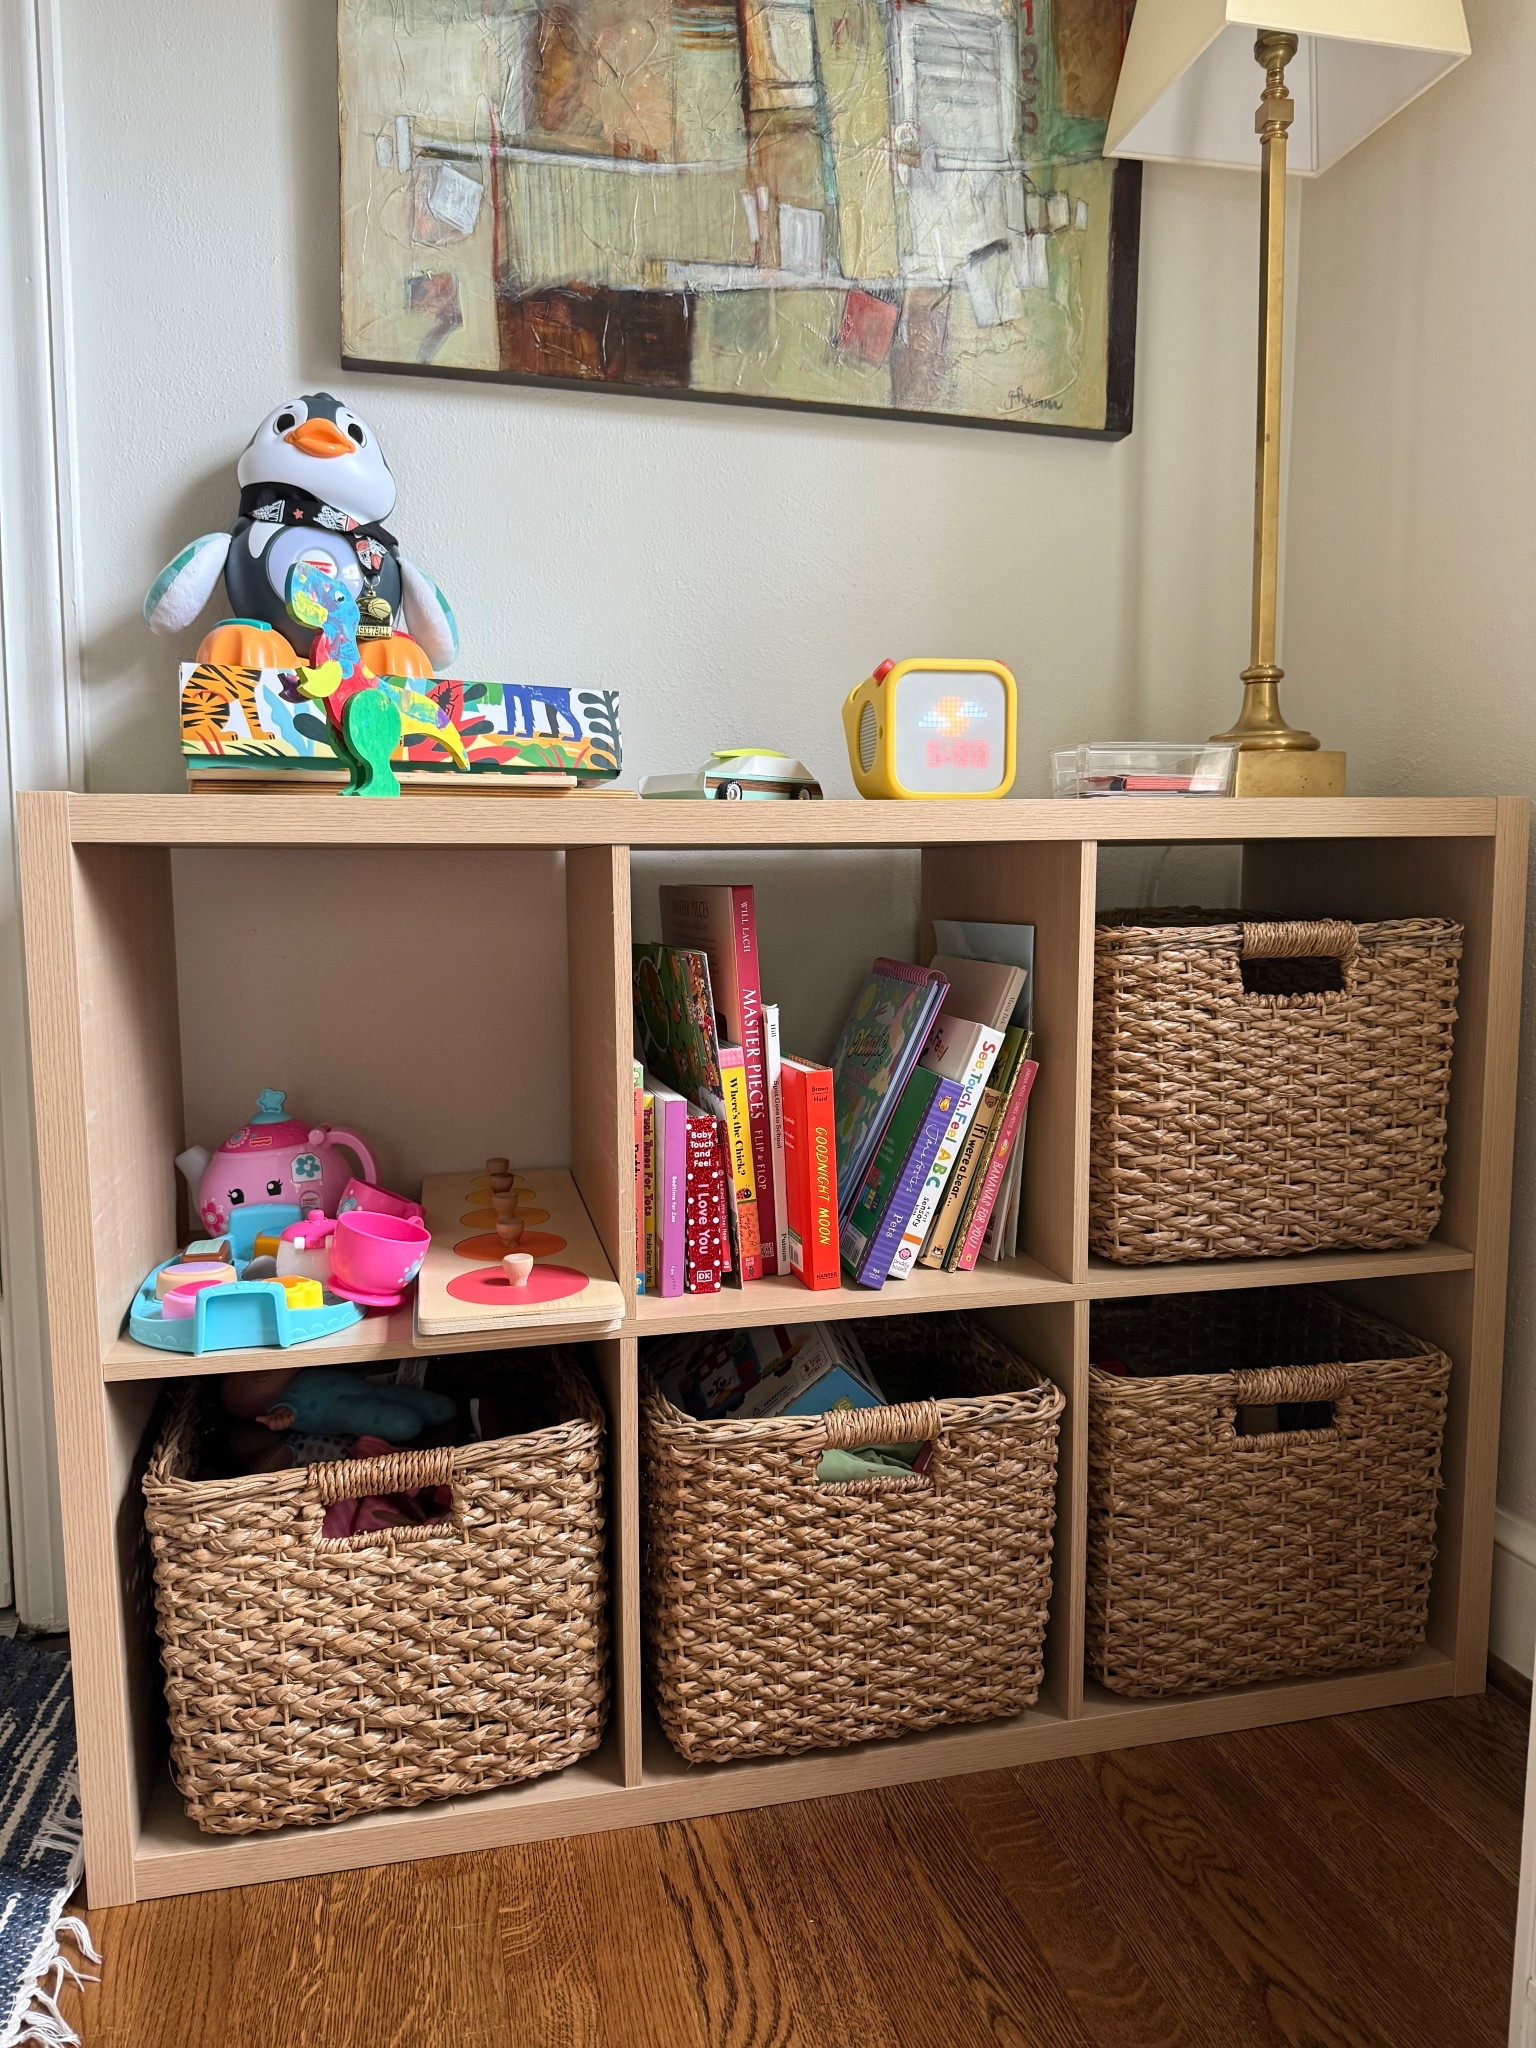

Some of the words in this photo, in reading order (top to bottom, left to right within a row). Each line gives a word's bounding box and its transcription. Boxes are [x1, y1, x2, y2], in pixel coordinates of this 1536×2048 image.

[741, 901, 749, 925] WILL
[742, 927, 751, 952] LACH
[730, 1077, 741, 1119] Where's
[644, 1107, 653, 1136] Truck
[734, 1121, 742, 1138] the
[945, 1112, 967, 1143] Feel
[974, 1123, 988, 1136] If
[690, 1139, 714, 1148] Touch
[691, 1130, 713, 1139] Baby
[755, 1130, 764, 1152] FLIP
[693, 1159, 711, 1167] Feel
[694, 1149, 711, 1158] and
[735, 1140, 746, 1175] Chick?
[963, 1139, 977, 1165] were
[815, 1127, 830, 1202] GOODNIGHT
[644, 1172, 653, 1190] For
[757, 1164, 767, 1190] FLOP
[981, 1161, 1004, 1207] BANANAS
[644, 1193, 653, 1216] Tots
[698, 1193, 710, 1225] Love
[975, 1207, 989, 1223] FOR
[818, 1207, 832, 1246] MOON
[886, 1213, 904, 1238] Pets
[968, 1225, 984, 1249] YOU!
[698, 1229, 711, 1255] You
[817, 1272, 838, 1280] HARPER
